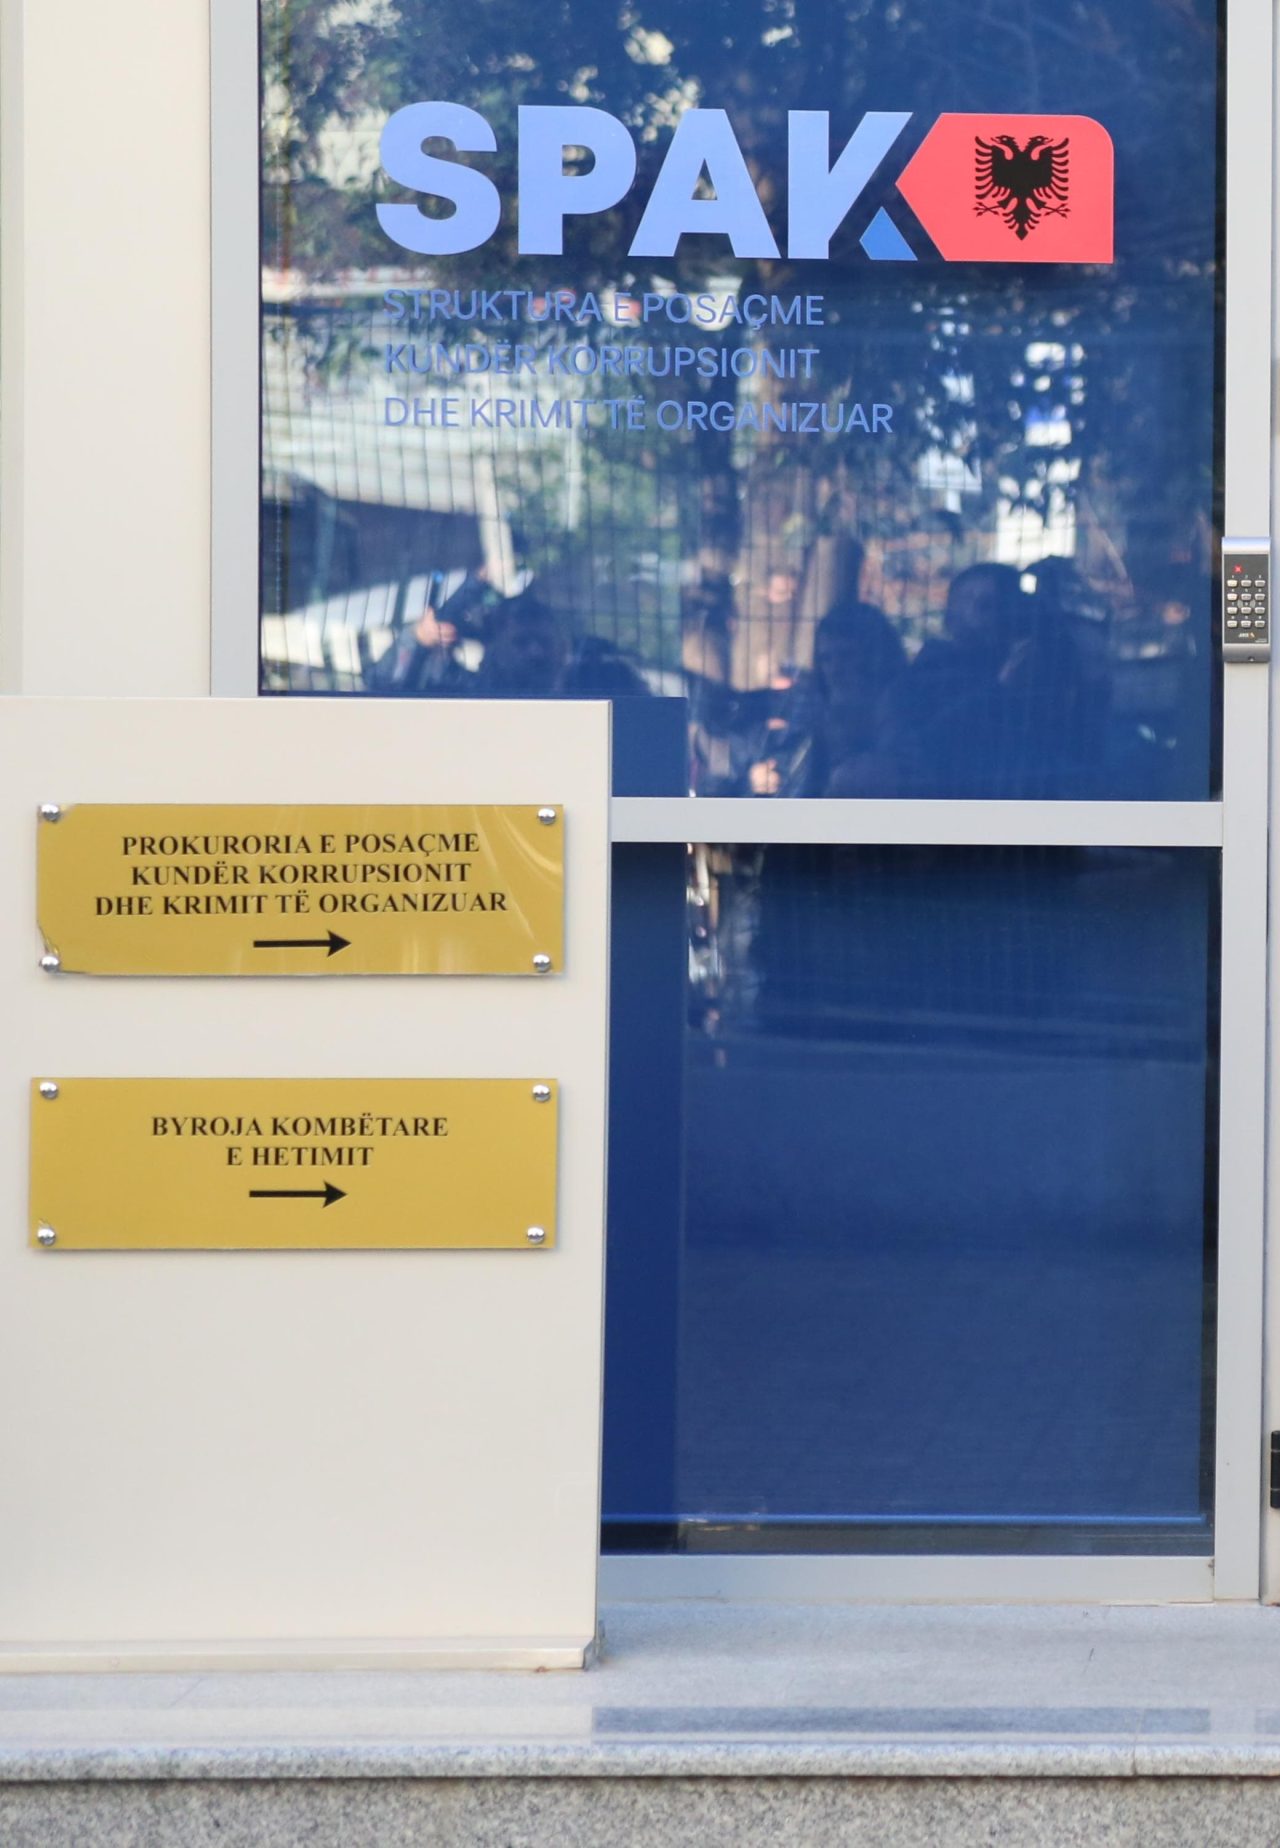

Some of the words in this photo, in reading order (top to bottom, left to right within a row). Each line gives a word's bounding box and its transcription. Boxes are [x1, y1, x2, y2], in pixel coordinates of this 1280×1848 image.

[376, 101, 917, 262] SPAK
[383, 289, 603, 321] STRUKTURA
[614, 292, 632, 322] E
[643, 293, 824, 330] POSAÇME
[385, 340, 536, 376] KUNDËR
[549, 345, 820, 379] KORRUPSIONIT
[384, 397, 459, 427] DHE
[471, 398, 597, 428] KRIMIT
[605, 394, 646, 430] TË
[656, 400, 894, 433] ORGANIZUAR
[121, 834, 312, 857] PROKURORIA
[319, 835, 336, 854] E
[344, 832, 480, 859] POSAÇME
[131, 861, 250, 886] KUNDËR
[259, 862, 471, 884] KORRUPSIONIT
[95, 896, 153, 917] DHE
[162, 895, 265, 915] KRIMIT
[275, 892, 310, 914] TË
[319, 892, 508, 913] ORGANIZUAR
[151, 1116, 263, 1138] BYROJA
[271, 1113, 448, 1138] KOMBËTARE
[226, 1146, 243, 1166] E
[251, 1146, 374, 1167] HETIMIT
